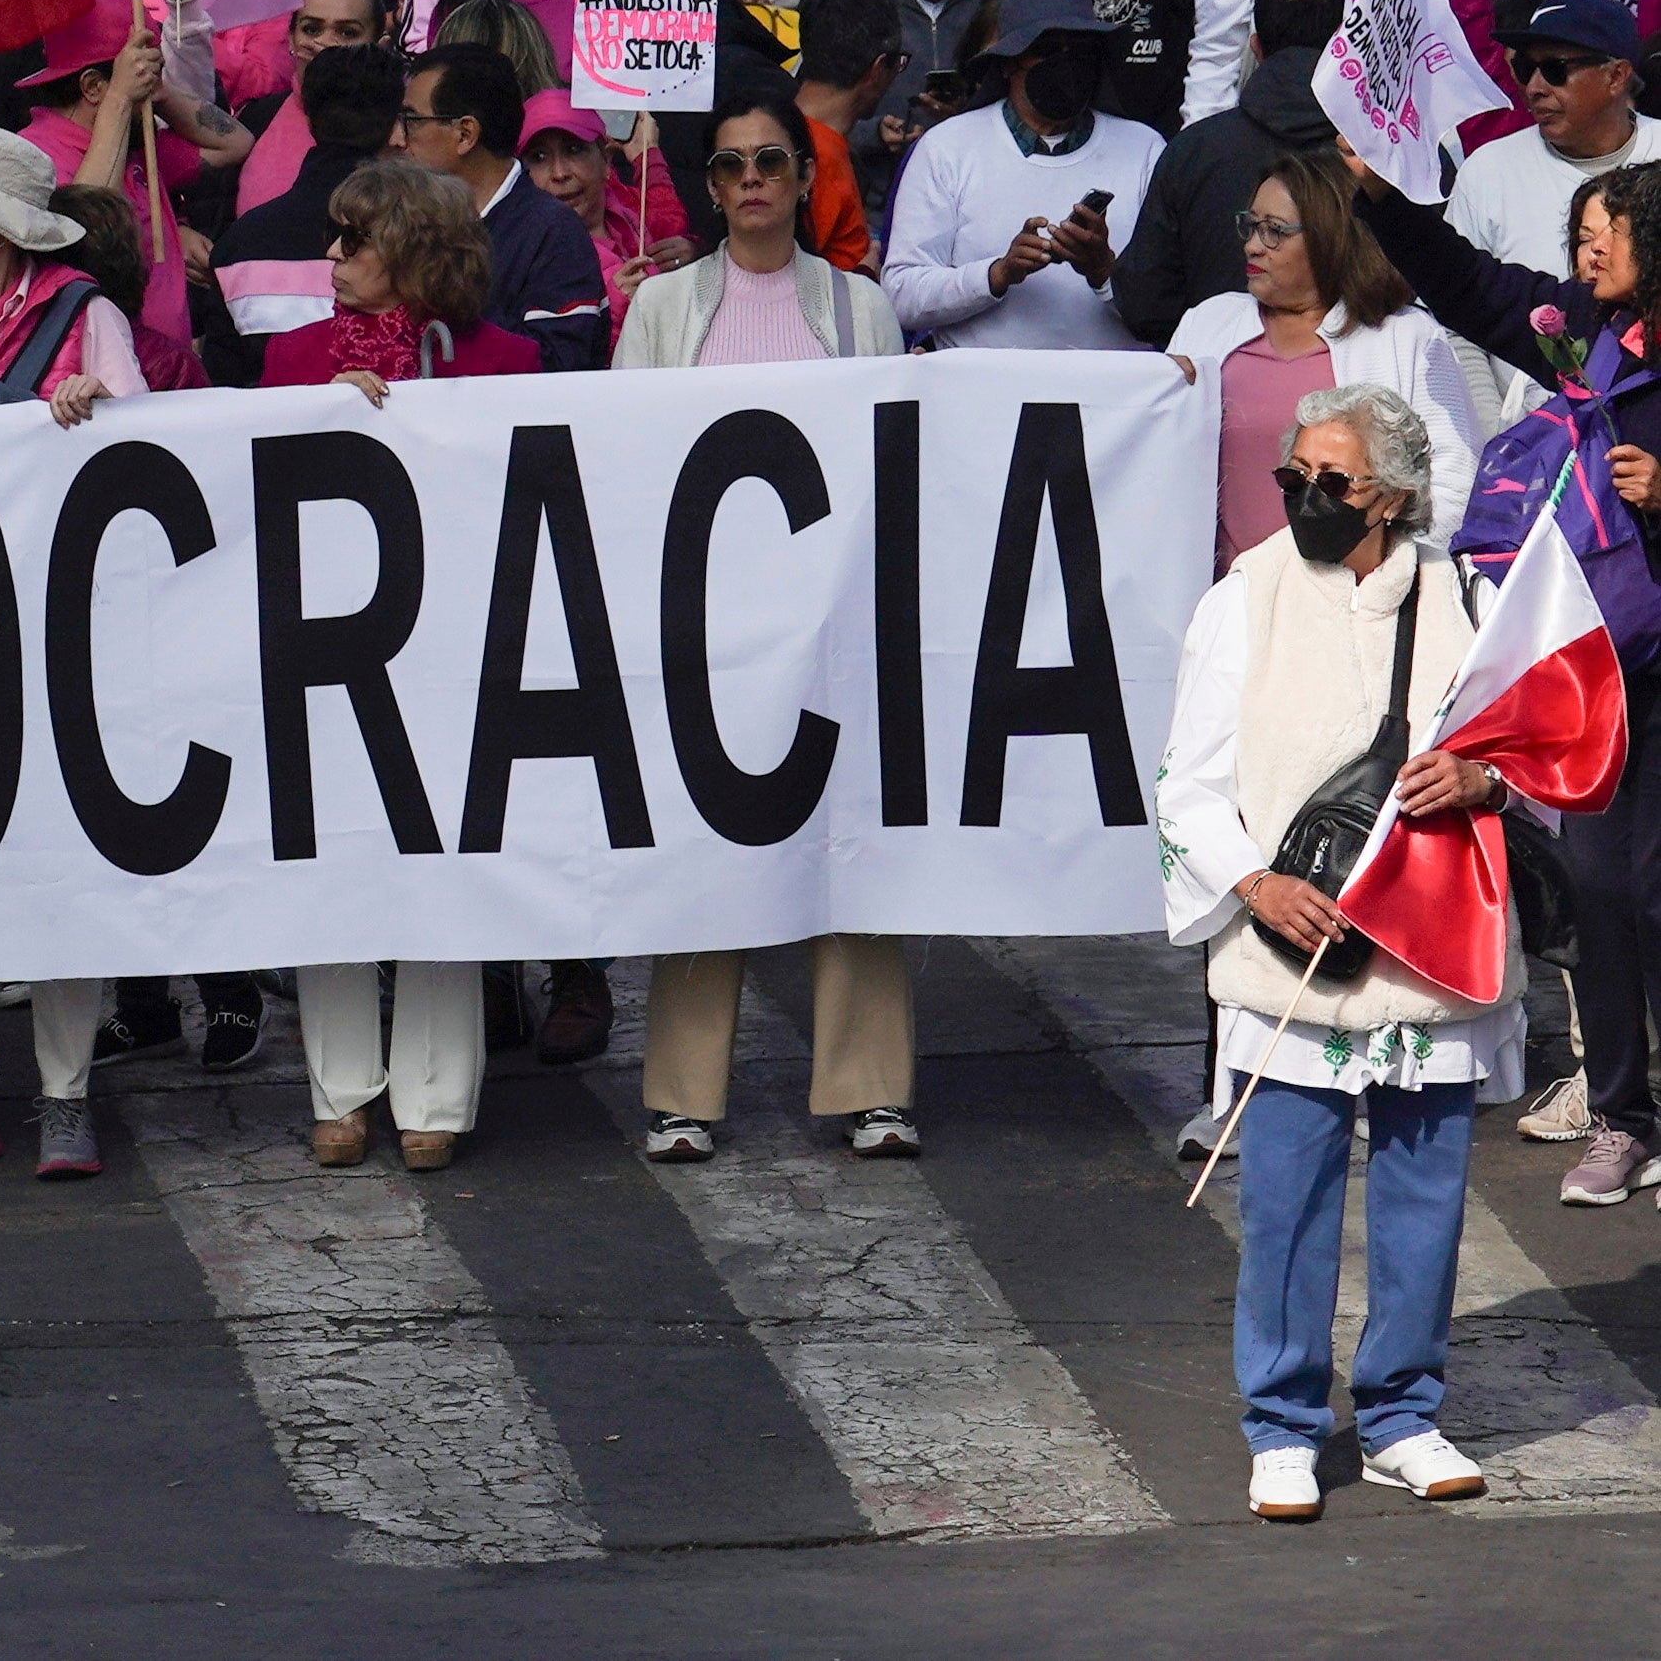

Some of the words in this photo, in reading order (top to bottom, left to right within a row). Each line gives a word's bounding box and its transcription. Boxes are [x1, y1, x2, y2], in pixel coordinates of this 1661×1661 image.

[583, 8, 717, 43] DEMOCRACIA
[588, 38, 623, 70] NO
[1131, 38, 1164, 56] CLUB
[1343, 5, 1398, 120] DEMOCRACIA
